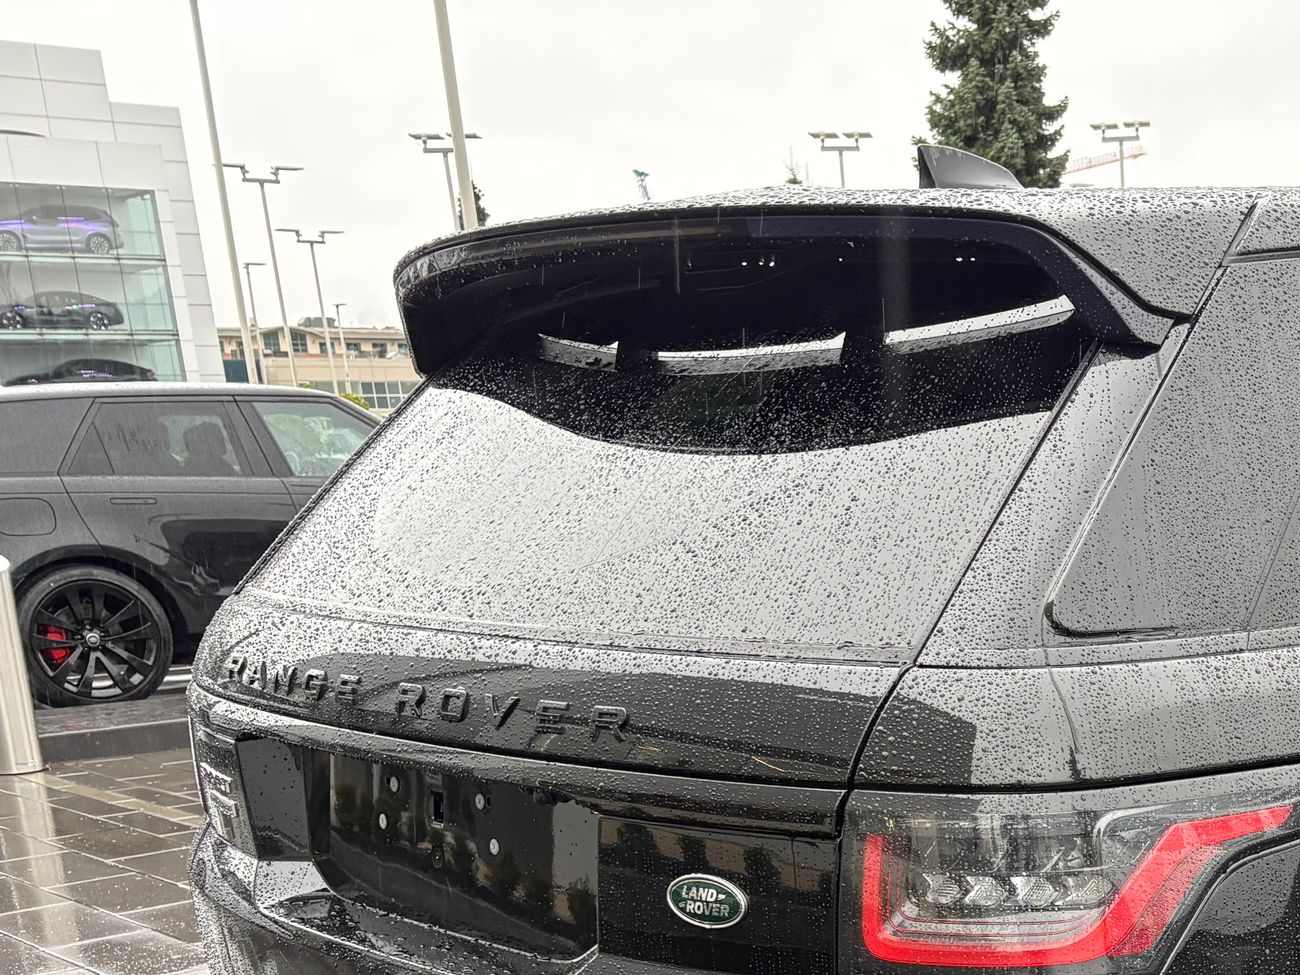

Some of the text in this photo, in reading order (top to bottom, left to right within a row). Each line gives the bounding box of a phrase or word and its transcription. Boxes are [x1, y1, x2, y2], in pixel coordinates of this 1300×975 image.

[224, 656, 628, 742] RANGE ROVER
[682, 885, 717, 902] LAND
[686, 900, 730, 917] ROVER
